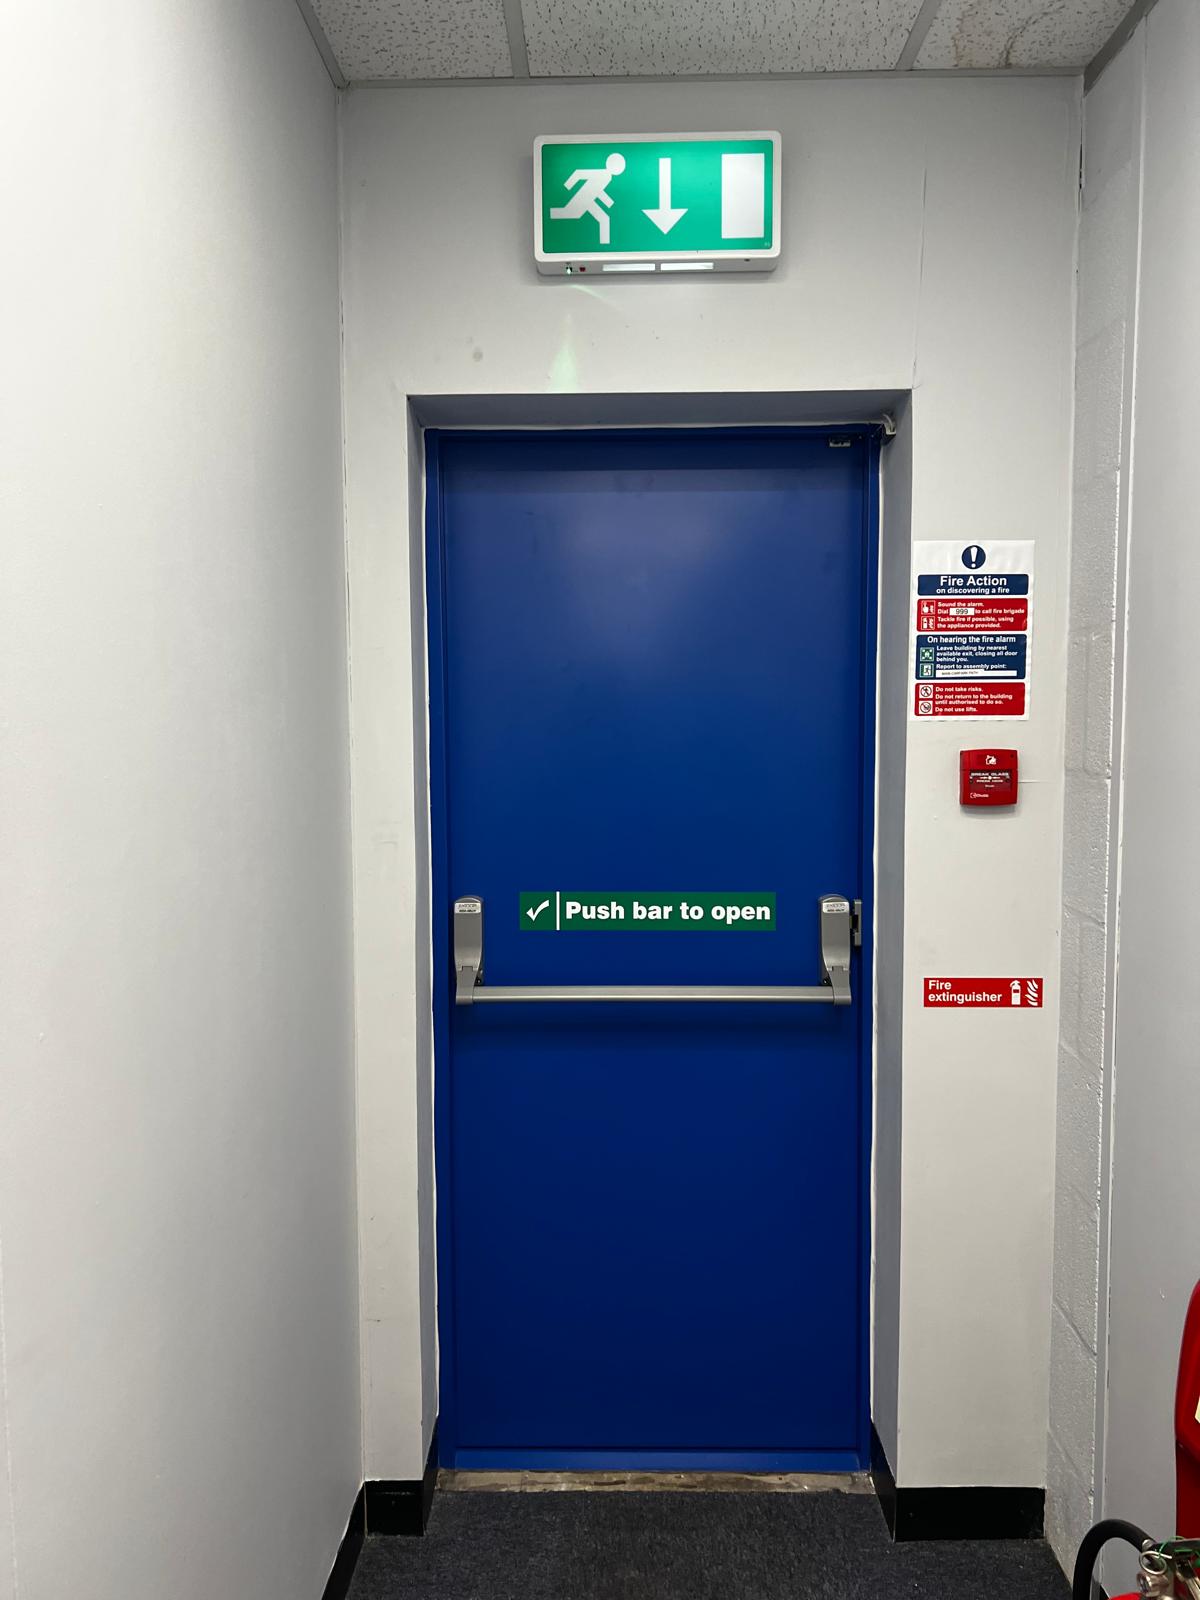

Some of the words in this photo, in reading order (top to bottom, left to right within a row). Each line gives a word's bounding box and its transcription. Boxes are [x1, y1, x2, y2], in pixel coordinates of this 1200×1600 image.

[940, 576, 963, 586] Fire
[967, 576, 1007, 586] Action
[940, 636, 967, 644] hearing
[566, 901, 624, 920] Push
[633, 901, 672, 920] bar
[680, 902, 703, 920] to
[711, 905, 771, 924] open
[929, 980, 951, 990] Fire
[928, 992, 1002, 1004] extinguisher
